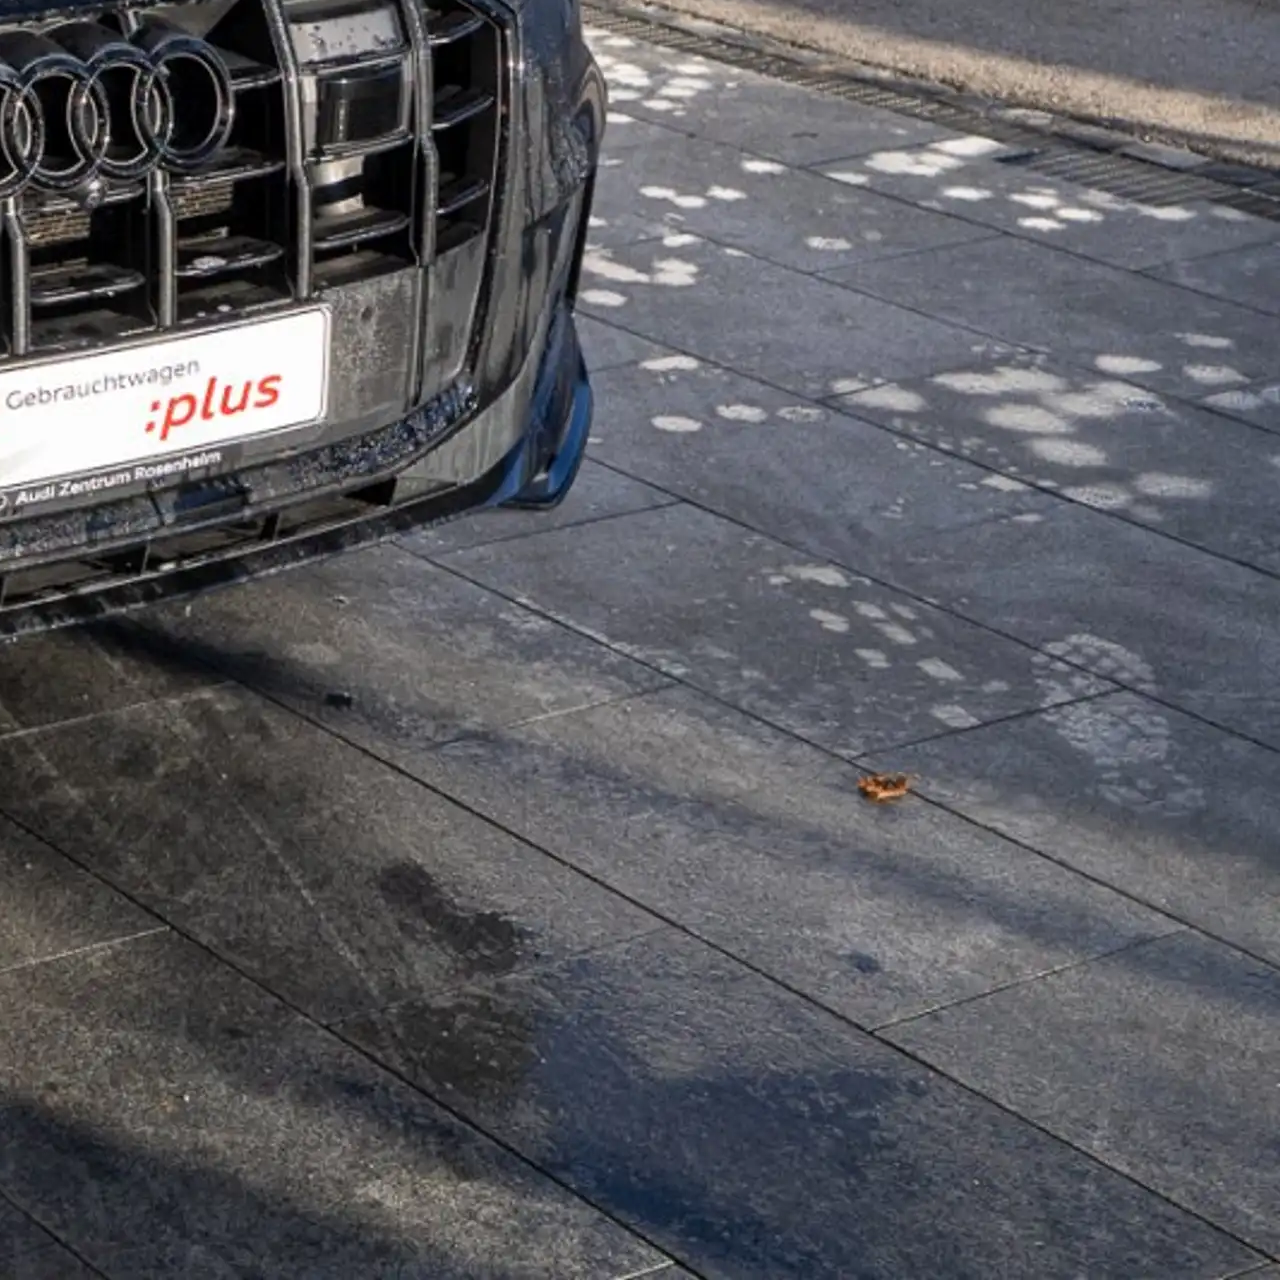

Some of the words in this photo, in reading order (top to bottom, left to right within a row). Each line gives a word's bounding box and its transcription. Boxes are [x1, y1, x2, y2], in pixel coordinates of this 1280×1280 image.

[5, 359, 200, 410] Gebrauchtwagen
[145, 374, 282, 441] :plus
[15, 486, 56, 506] Audi
[58, 470, 131, 497] Zentrum
[135, 451, 221, 480] Rosenheim
